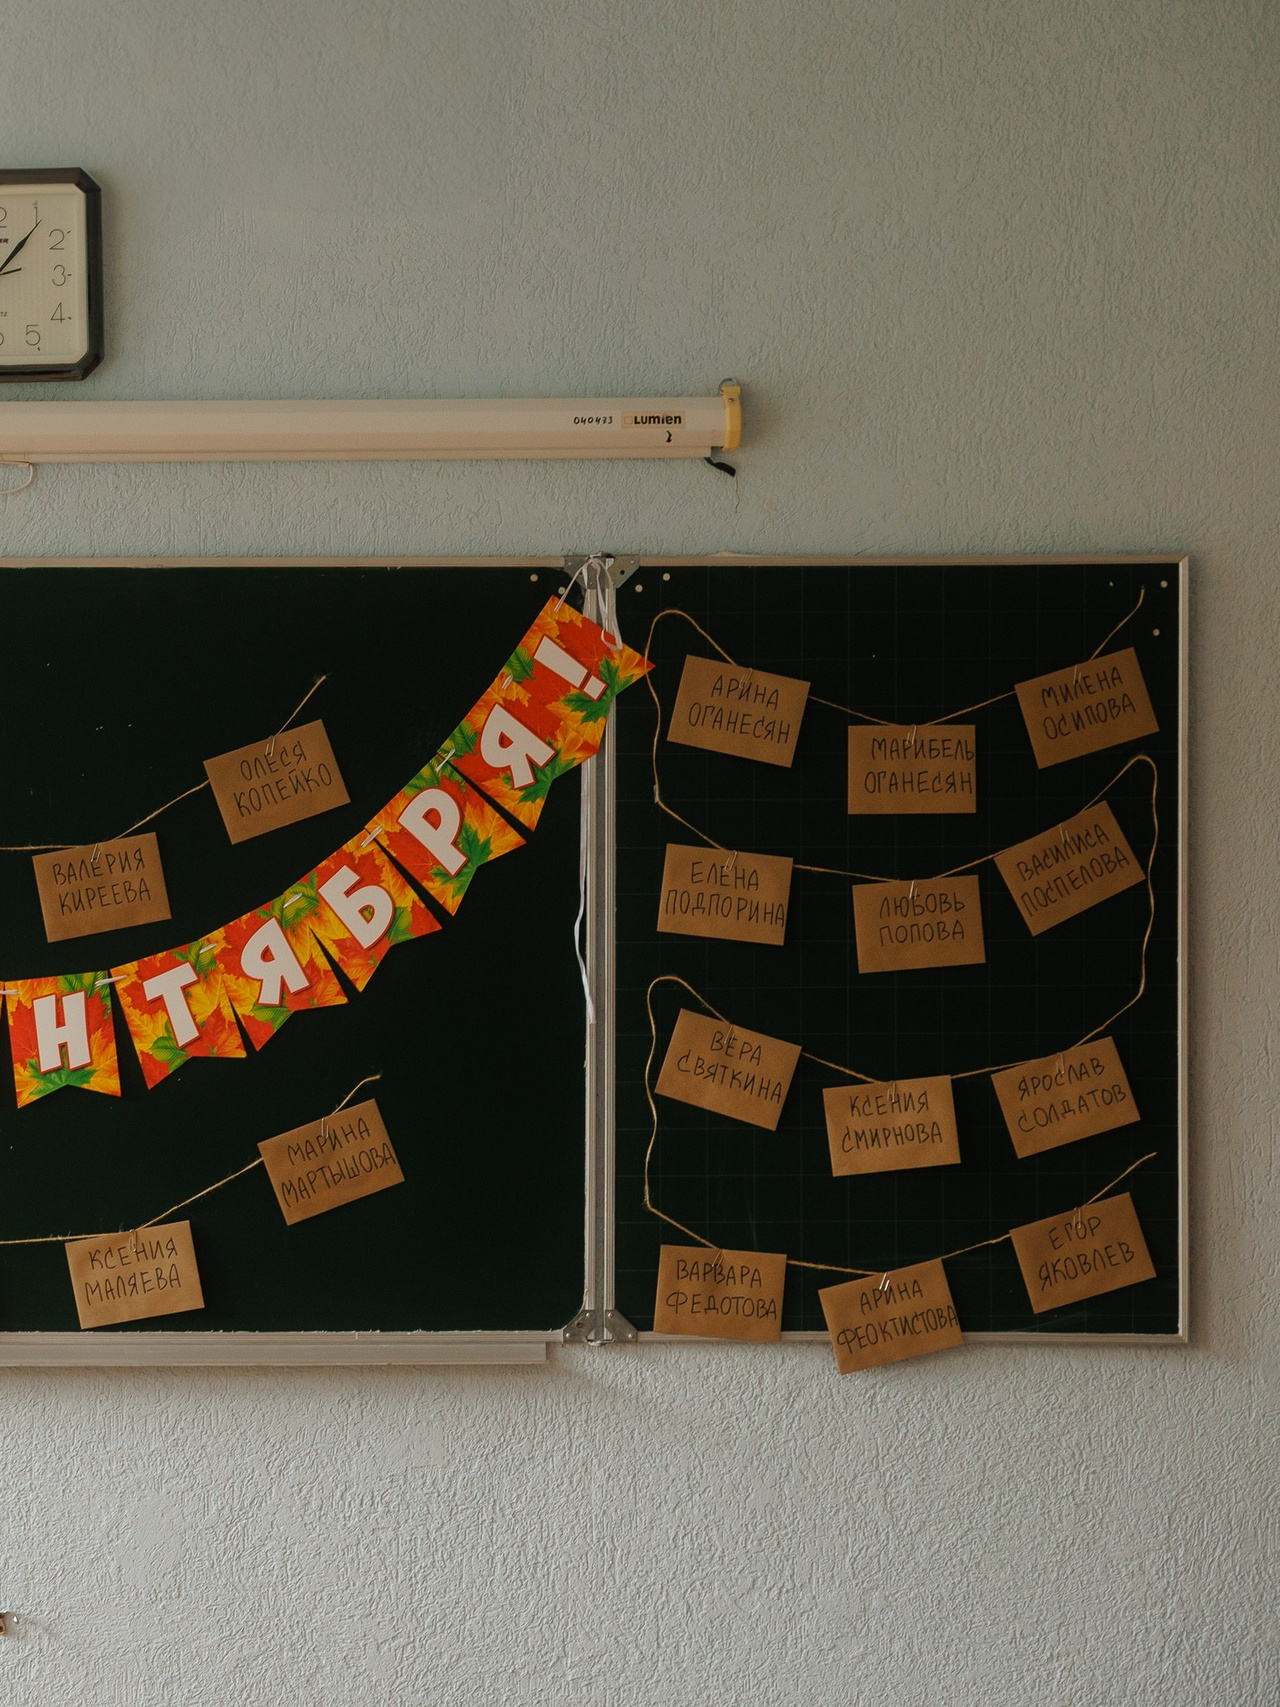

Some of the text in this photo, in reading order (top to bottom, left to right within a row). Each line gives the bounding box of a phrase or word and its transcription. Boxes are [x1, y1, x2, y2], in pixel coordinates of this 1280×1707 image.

[34, 207, 38, 225] 1
[49, 229, 65, 250] 2
[52, 265, 66, 286] 3
[50, 302, 65, 323] 4
[25, 324, 41, 346] 5
[711, 674, 780, 710] АРИНА
[1040, 666, 1124, 709] МИЛЕНА
[688, 702, 791, 745] ОГАНЕСЯН
[1043, 693, 1136, 740] ОСИПОВА
[240, 741, 307, 782] ОЛЕСЯ
[871, 737, 975, 761] МАРИБЕЛЬ
[233, 762, 331, 818] КОПЕЙКО
[864, 770, 972, 795] ОГАНЕСЯН
[52, 848, 146, 885] ВАЛЕРИЯ
[1015, 823, 1110, 882] ВАСИЛИСА
[690, 861, 759, 892] ЕЛЕНА
[1022, 845, 1130, 918] ПОСПЕЛОВА
[58, 877, 151, 916] КИРЕЕВА
[665, 890, 785, 927] ПОДПОРИНА
[878, 891, 965, 920] ЛЮБОВЬ
[879, 919, 964, 947] ПОПОВА
[710, 1030, 762, 1066] ВЕРА
[677, 1048, 782, 1105] СВЯТКИНА
[1017, 1057, 1105, 1100] ЯРОСЛАВ
[849, 1092, 929, 1117] КСЕНИЯ
[1017, 1084, 1126, 1132] СОЛДАТОВ
[287, 1117, 370, 1166] МАРИНА
[841, 1122, 942, 1153] СМИРНОВА
[281, 1142, 396, 1208] МАРТЫШОВА
[1049, 1216, 1101, 1251] ЕГОР
[88, 1237, 178, 1271] КСЕНИЯ
[1038, 1241, 1135, 1290] ЯКОВЛЕВ
[84, 1263, 181, 1306] МАЛЯЕВА
[676, 1259, 762, 1288] ВАРВАРА
[666, 1290, 777, 1321] ФЕДОТОВА
[860, 1279, 923, 1315] АРИНА
[837, 1305, 959, 1353] ФЕОКТИСТОВА
